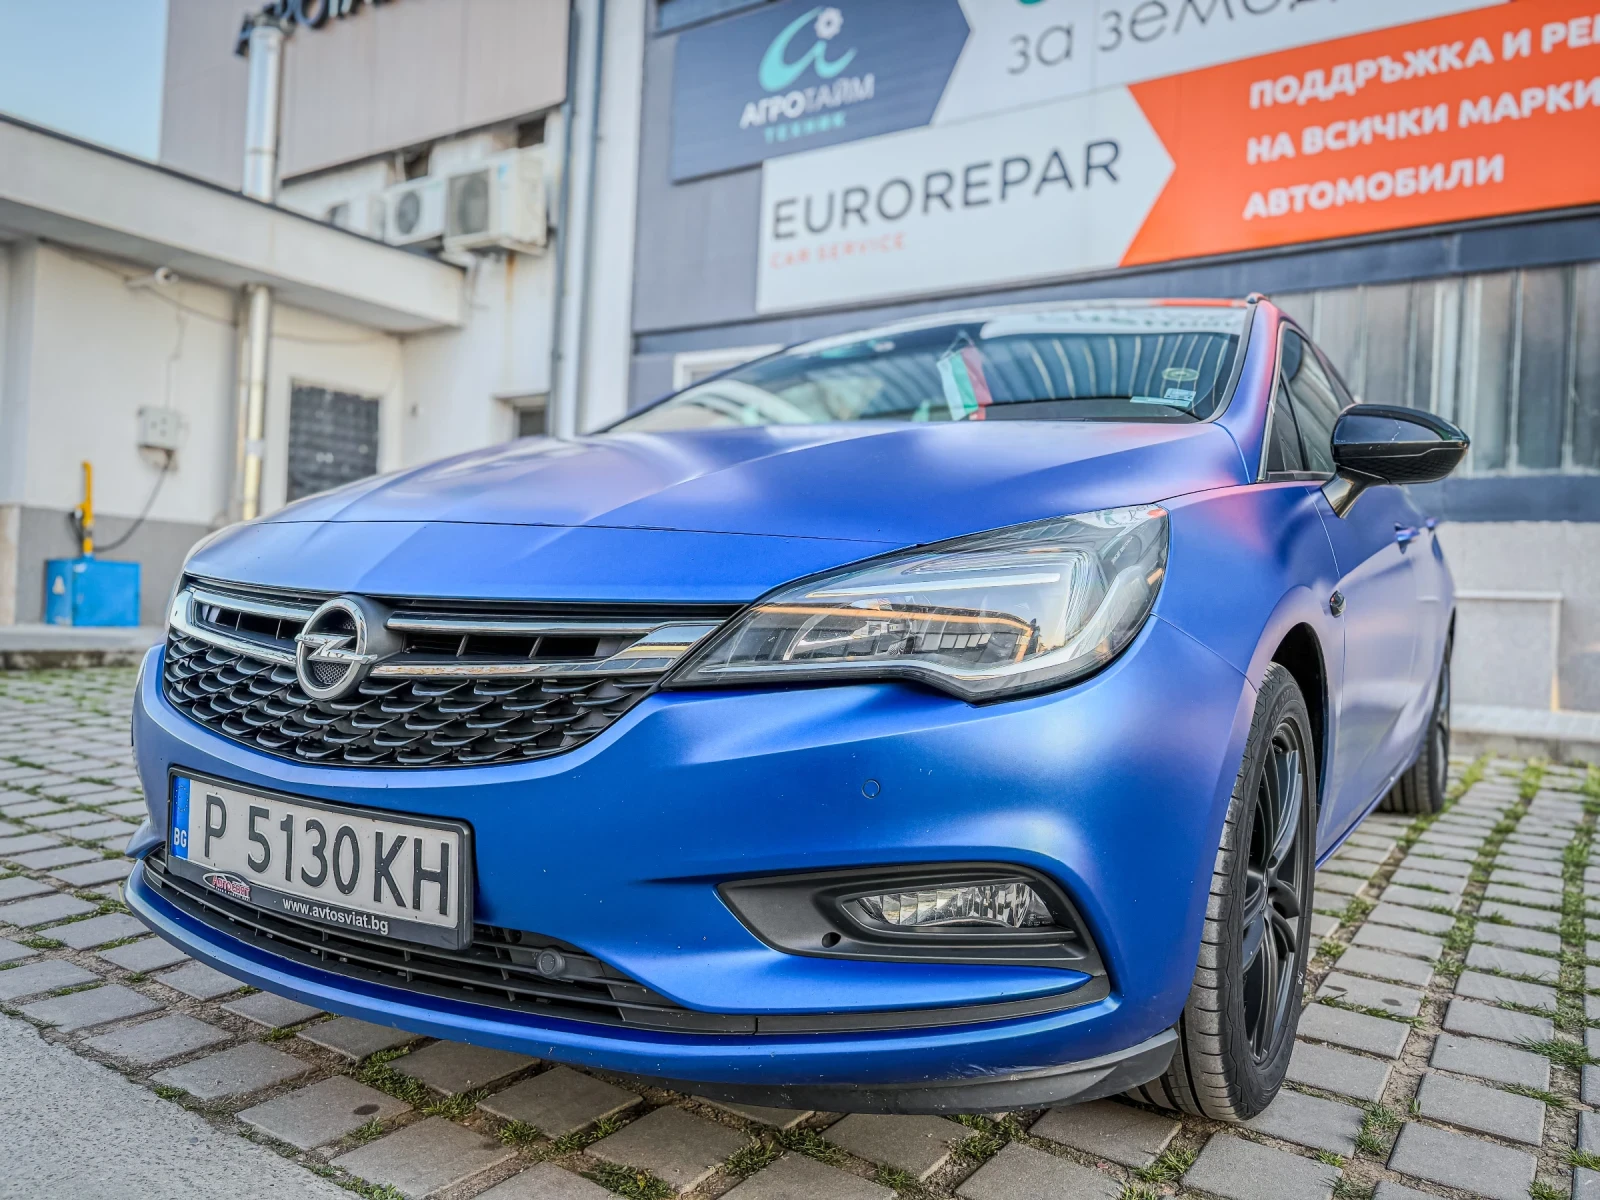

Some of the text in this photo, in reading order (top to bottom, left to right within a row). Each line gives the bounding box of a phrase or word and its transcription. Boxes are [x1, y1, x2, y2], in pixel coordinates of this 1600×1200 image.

[1249, 14, 1600, 109] ПОДДРЪЖКА И РЕ
[1246, 76, 1600, 166] НА ВСИЧКИ МАРКИ
[773, 139, 1120, 240] EUROREPAR
[1242, 154, 1505, 221] АВТОМОБИЛИ
[769, 232, 905, 268] CAR SERVICE
[173, 827, 187, 848] BG
[247, 805, 360, 895] 5130
[283, 898, 389, 935] www.avtosviat.bg
